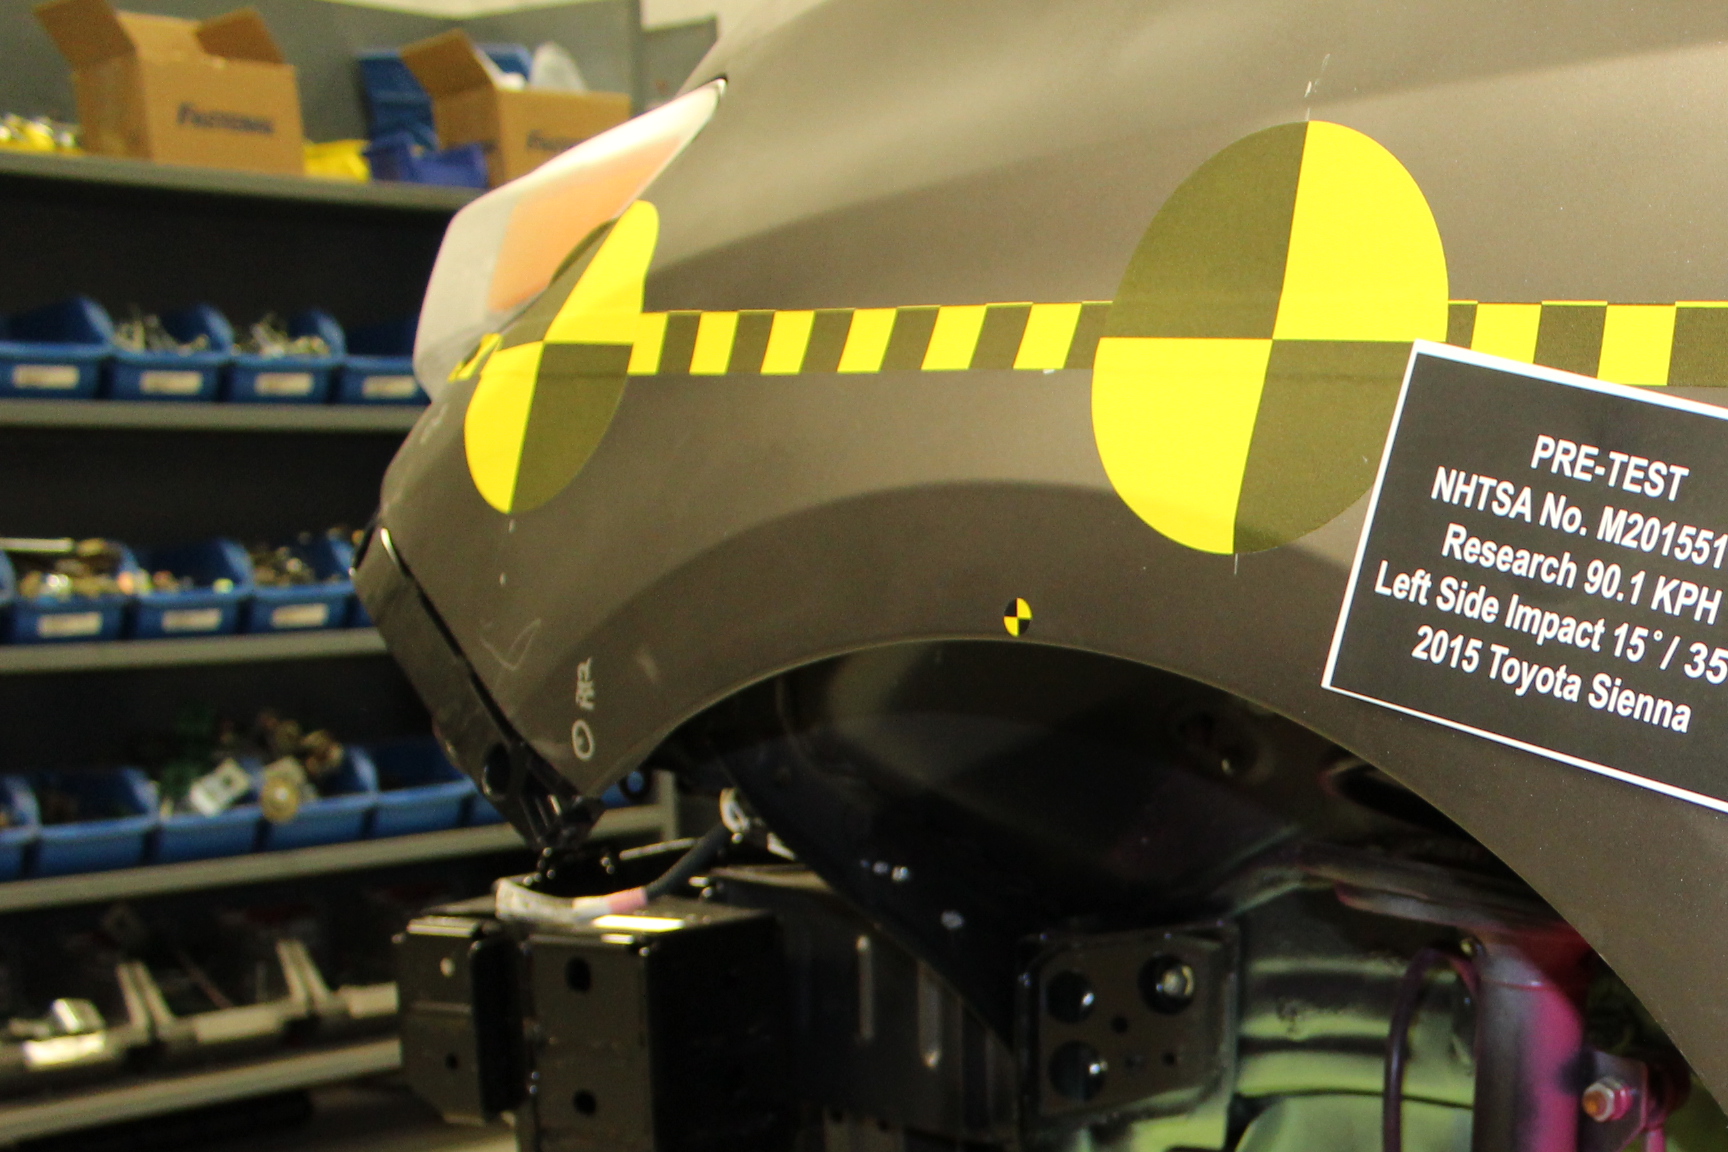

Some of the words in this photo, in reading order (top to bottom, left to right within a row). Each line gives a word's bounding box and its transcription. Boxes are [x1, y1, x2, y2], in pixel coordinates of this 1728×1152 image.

[1430, 465, 1532, 523] NHTSA
[1538, 491, 1587, 537] No.
[1530, 434, 1690, 502] PRE-TEST
[1374, 559, 1433, 606] Left
[1435, 576, 1500, 624] Side
[1504, 593, 1606, 653] Impact
[1441, 522, 1578, 589] Research
[1583, 559, 1646, 606] 90.1
[1650, 575, 1723, 625] KPH
[1411, 625, 1483, 673] 2015
[1489, 643, 1582, 703] Toyota
[1587, 672, 1692, 734] Sienna
